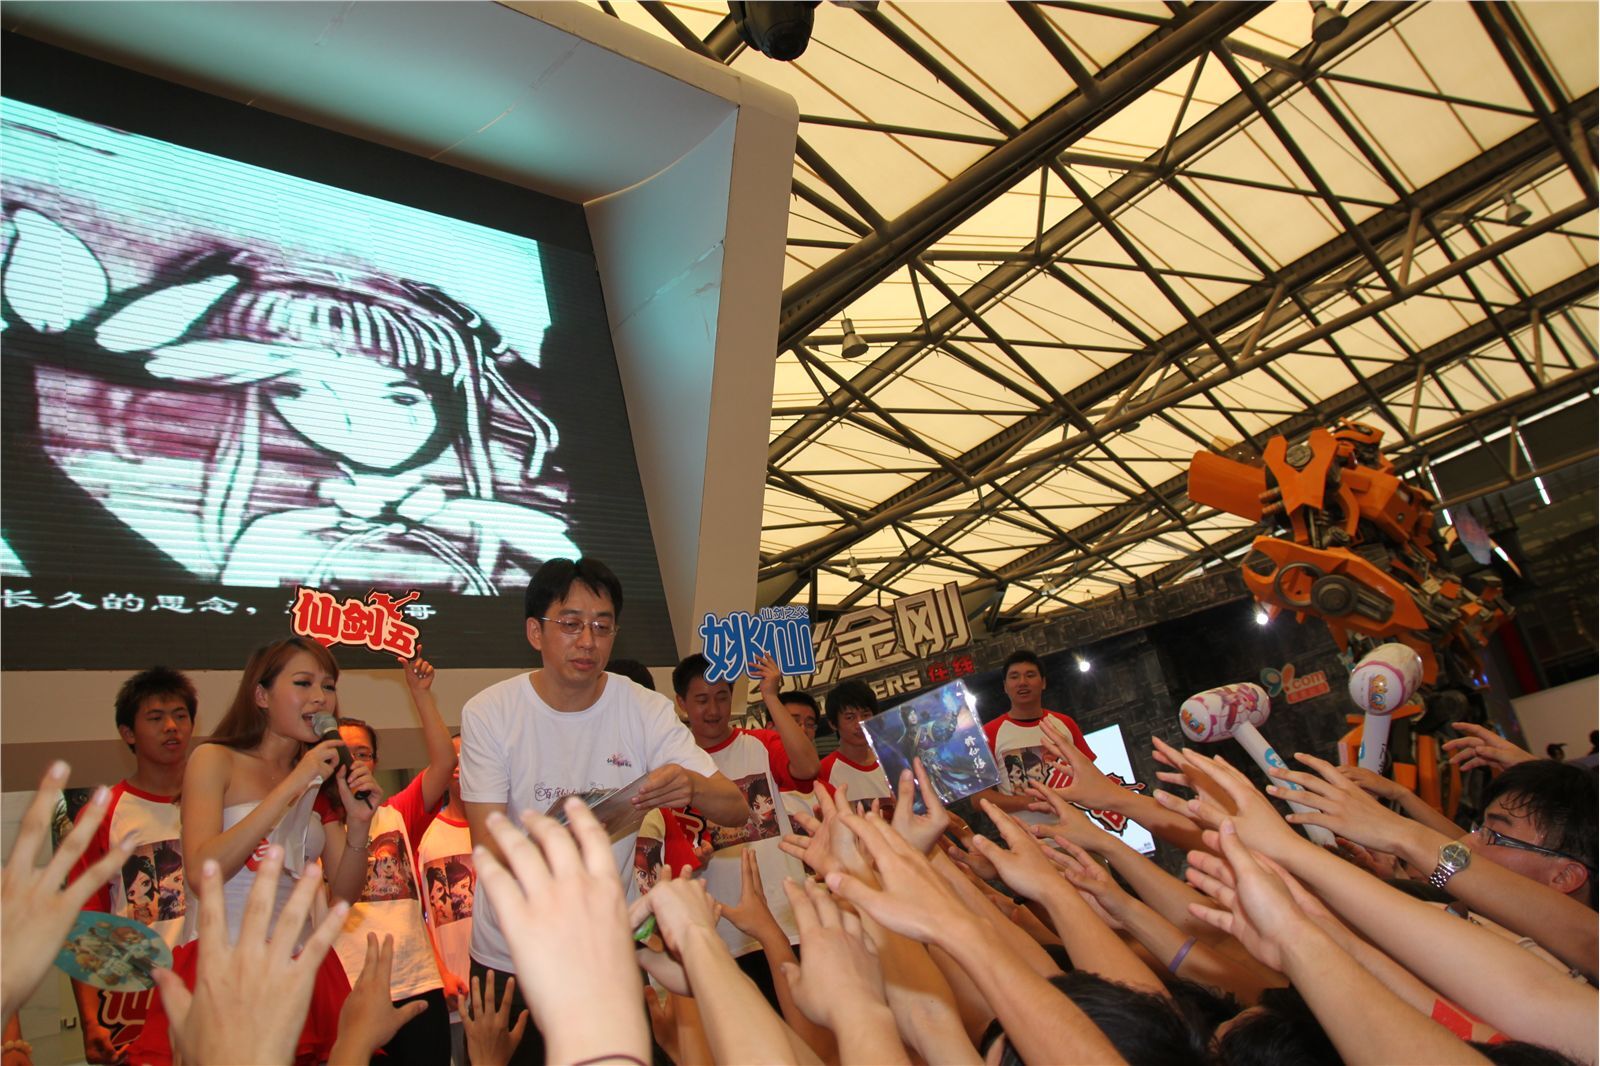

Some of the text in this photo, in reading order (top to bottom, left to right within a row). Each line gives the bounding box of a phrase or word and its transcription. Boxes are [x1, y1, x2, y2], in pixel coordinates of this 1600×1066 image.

[295, 590, 419, 658] 仙剑五
[760, 605, 809, 622] 仙剑之父
[699, 612, 816, 682] 姚仙
[927, 655, 975, 682] 在线
